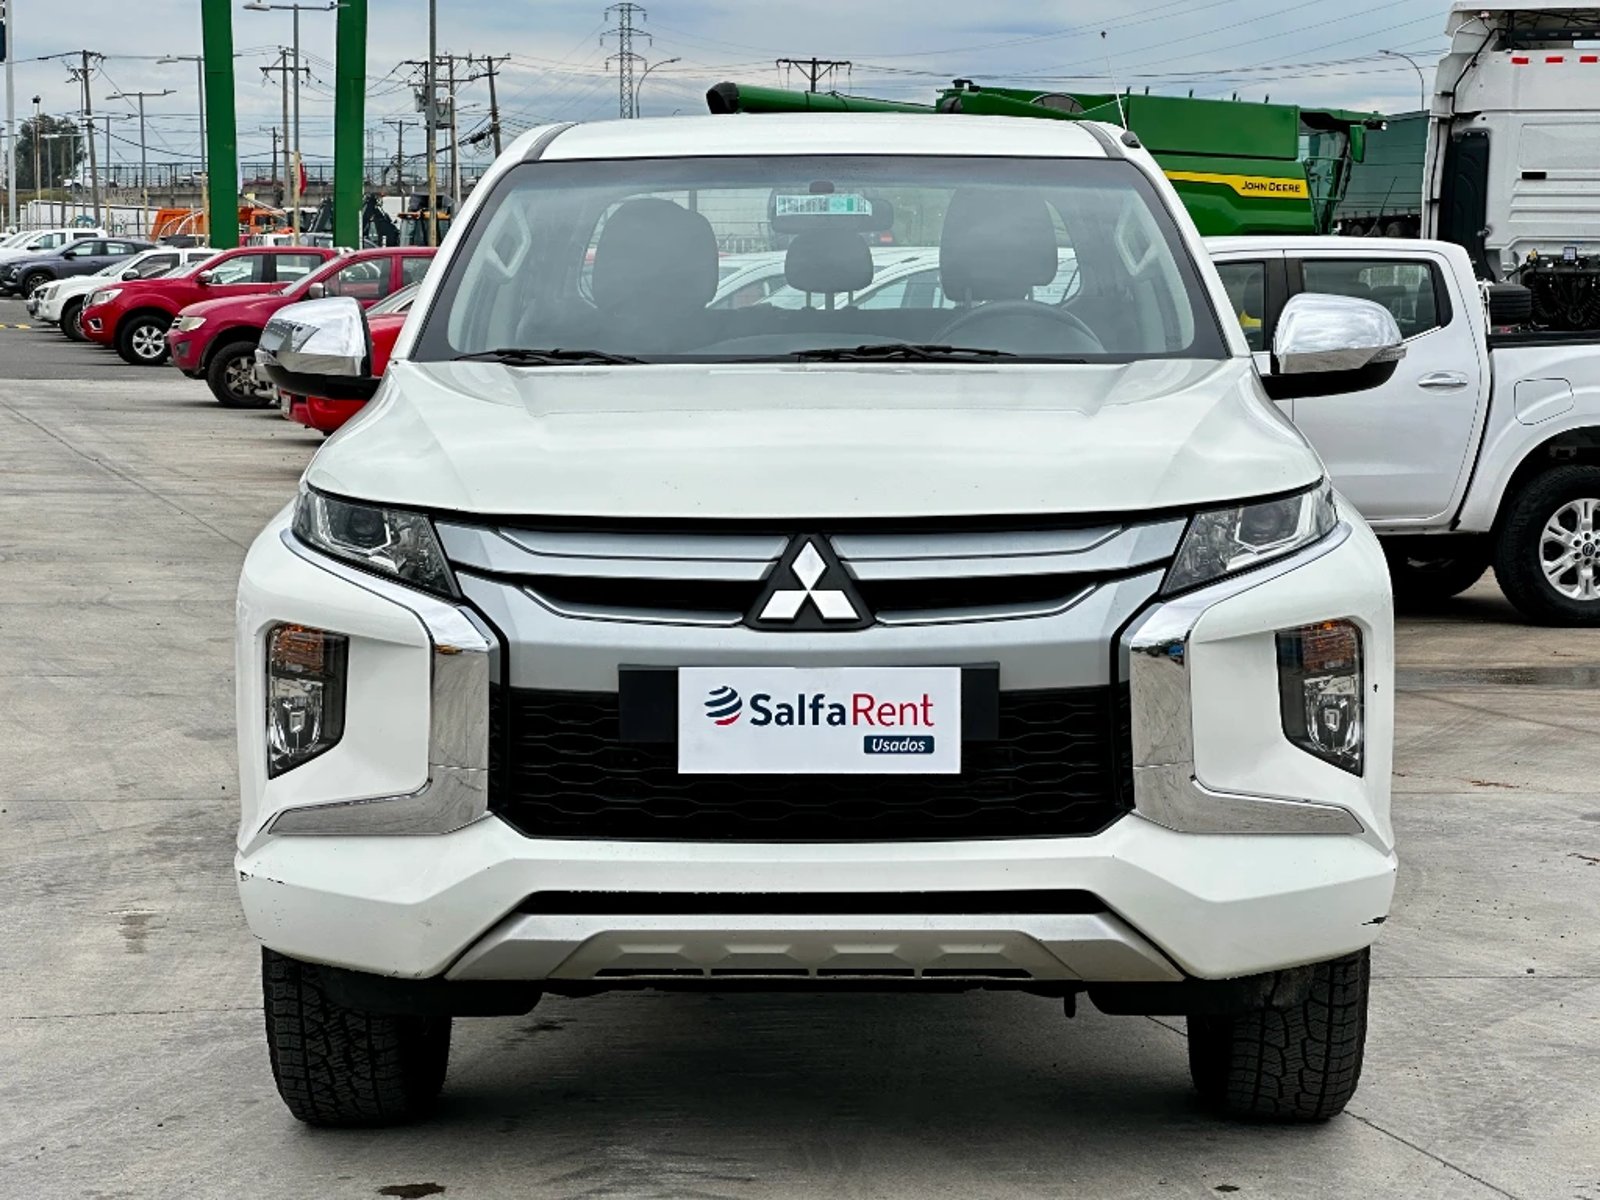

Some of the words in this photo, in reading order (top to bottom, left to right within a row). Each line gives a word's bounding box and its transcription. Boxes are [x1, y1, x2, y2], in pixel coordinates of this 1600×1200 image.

[1241, 180, 1267, 192] JOHN
[1269, 182, 1301, 193] DEERE
[749, 693, 935, 727] SalfaRent
[871, 737, 926, 752] Usados
